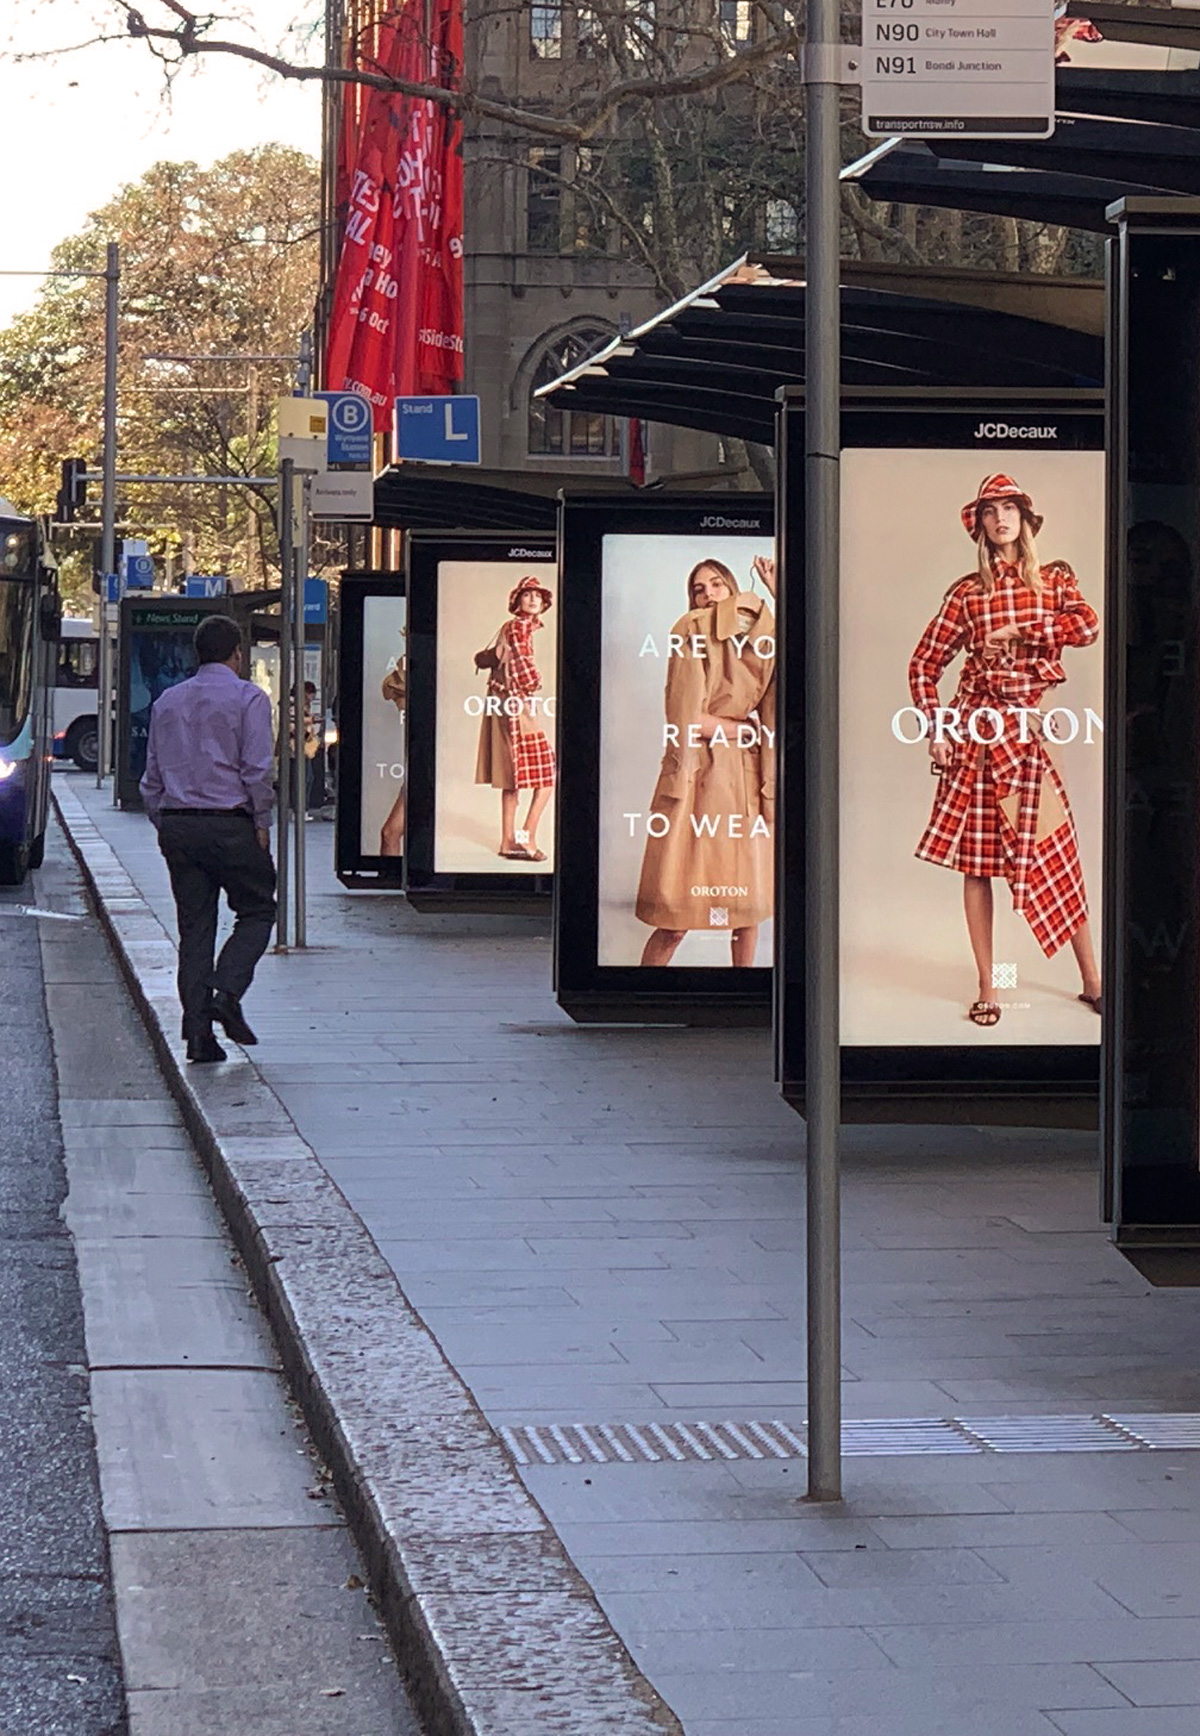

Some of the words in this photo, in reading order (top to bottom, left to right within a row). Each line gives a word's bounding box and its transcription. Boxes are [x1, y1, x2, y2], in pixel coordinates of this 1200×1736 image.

[876, 24, 919, 41] N90
[925, 28, 946, 39] City
[948, 28, 975, 38] Town
[976, 28, 997, 38] Hall
[876, 56, 917, 74] N91
[925, 61, 955, 70] Bondi
[957, 61, 1002, 71] Junction
[875, 119, 965, 131] transportnsw.info
[343, 405, 358, 424] B
[402, 403, 433, 414] Stand
[445, 403, 468, 441] L
[974, 423, 1058, 439] JCDecaux
[699, 515, 760, 529] JCDecaux
[508, 548, 553, 558] JCDecaux
[205, 579, 222, 597] M
[638, 633, 707, 658] ARE
[730, 635, 775, 658] YO
[623, 812, 670, 838] TO
[689, 813, 771, 838] WEA
[690, 885, 749, 898] OROTON
